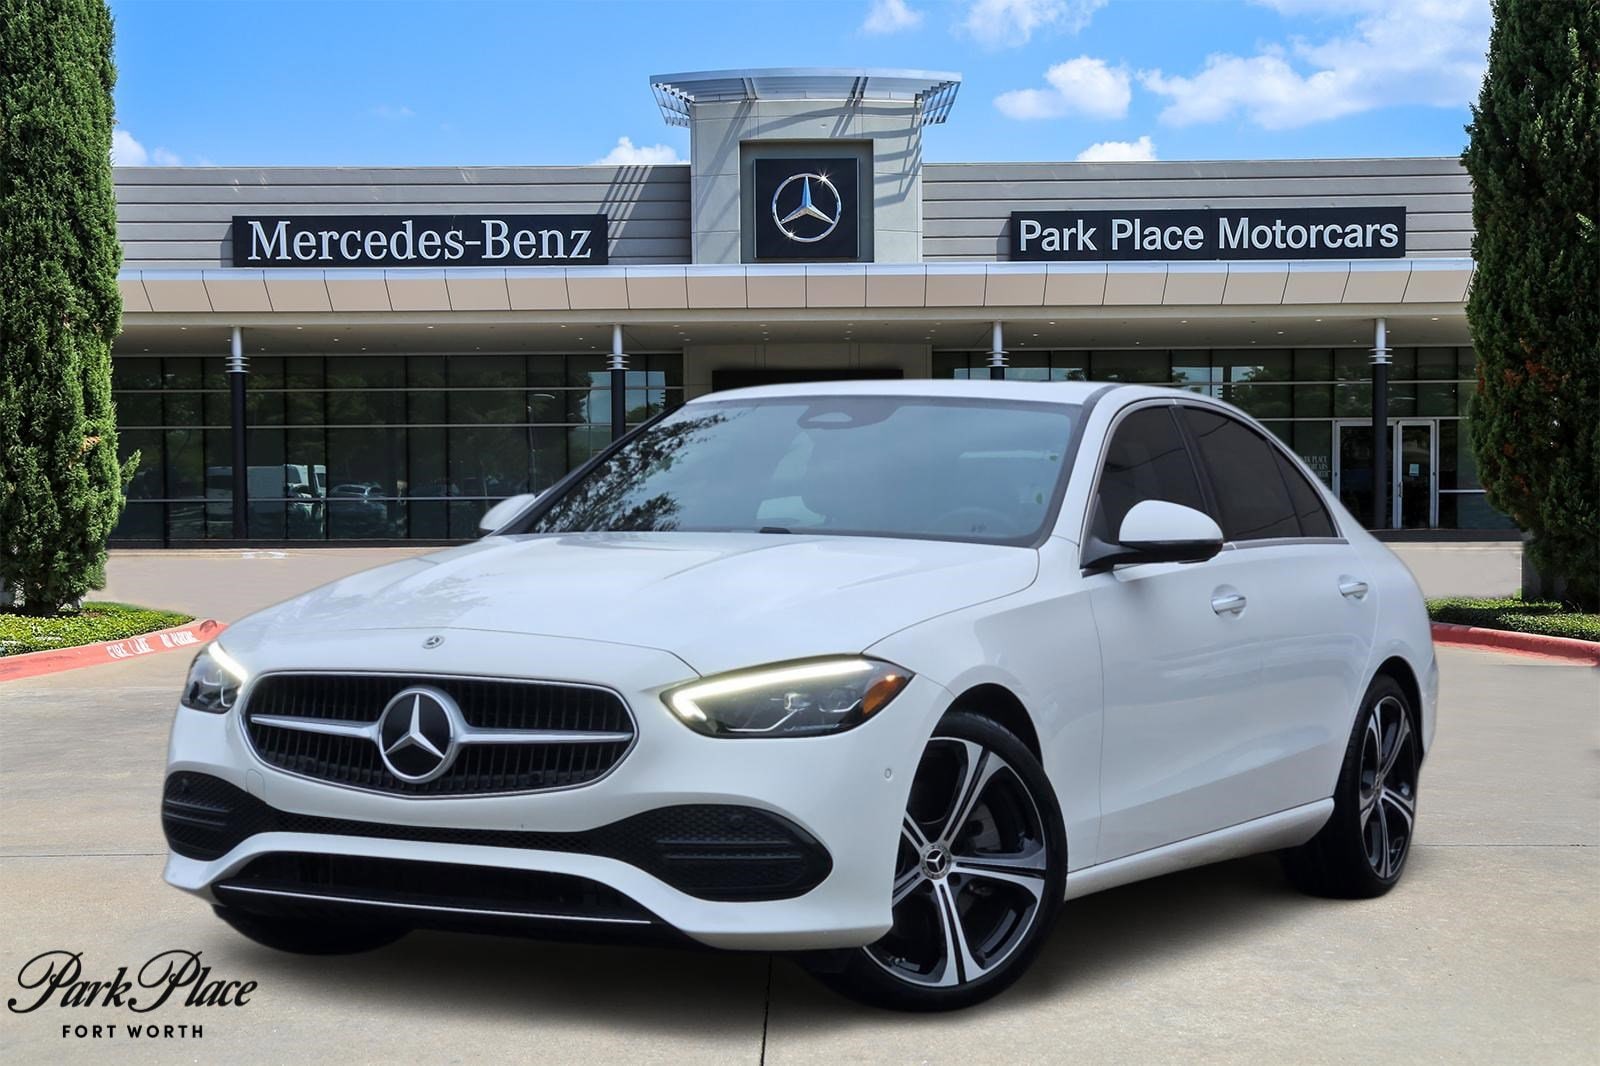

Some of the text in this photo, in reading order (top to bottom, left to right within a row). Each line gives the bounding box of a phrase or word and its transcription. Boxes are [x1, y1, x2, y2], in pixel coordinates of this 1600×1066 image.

[247, 219, 592, 261] Mercedes-Benz
[1019, 216, 1400, 252] Park Place Motorcars
